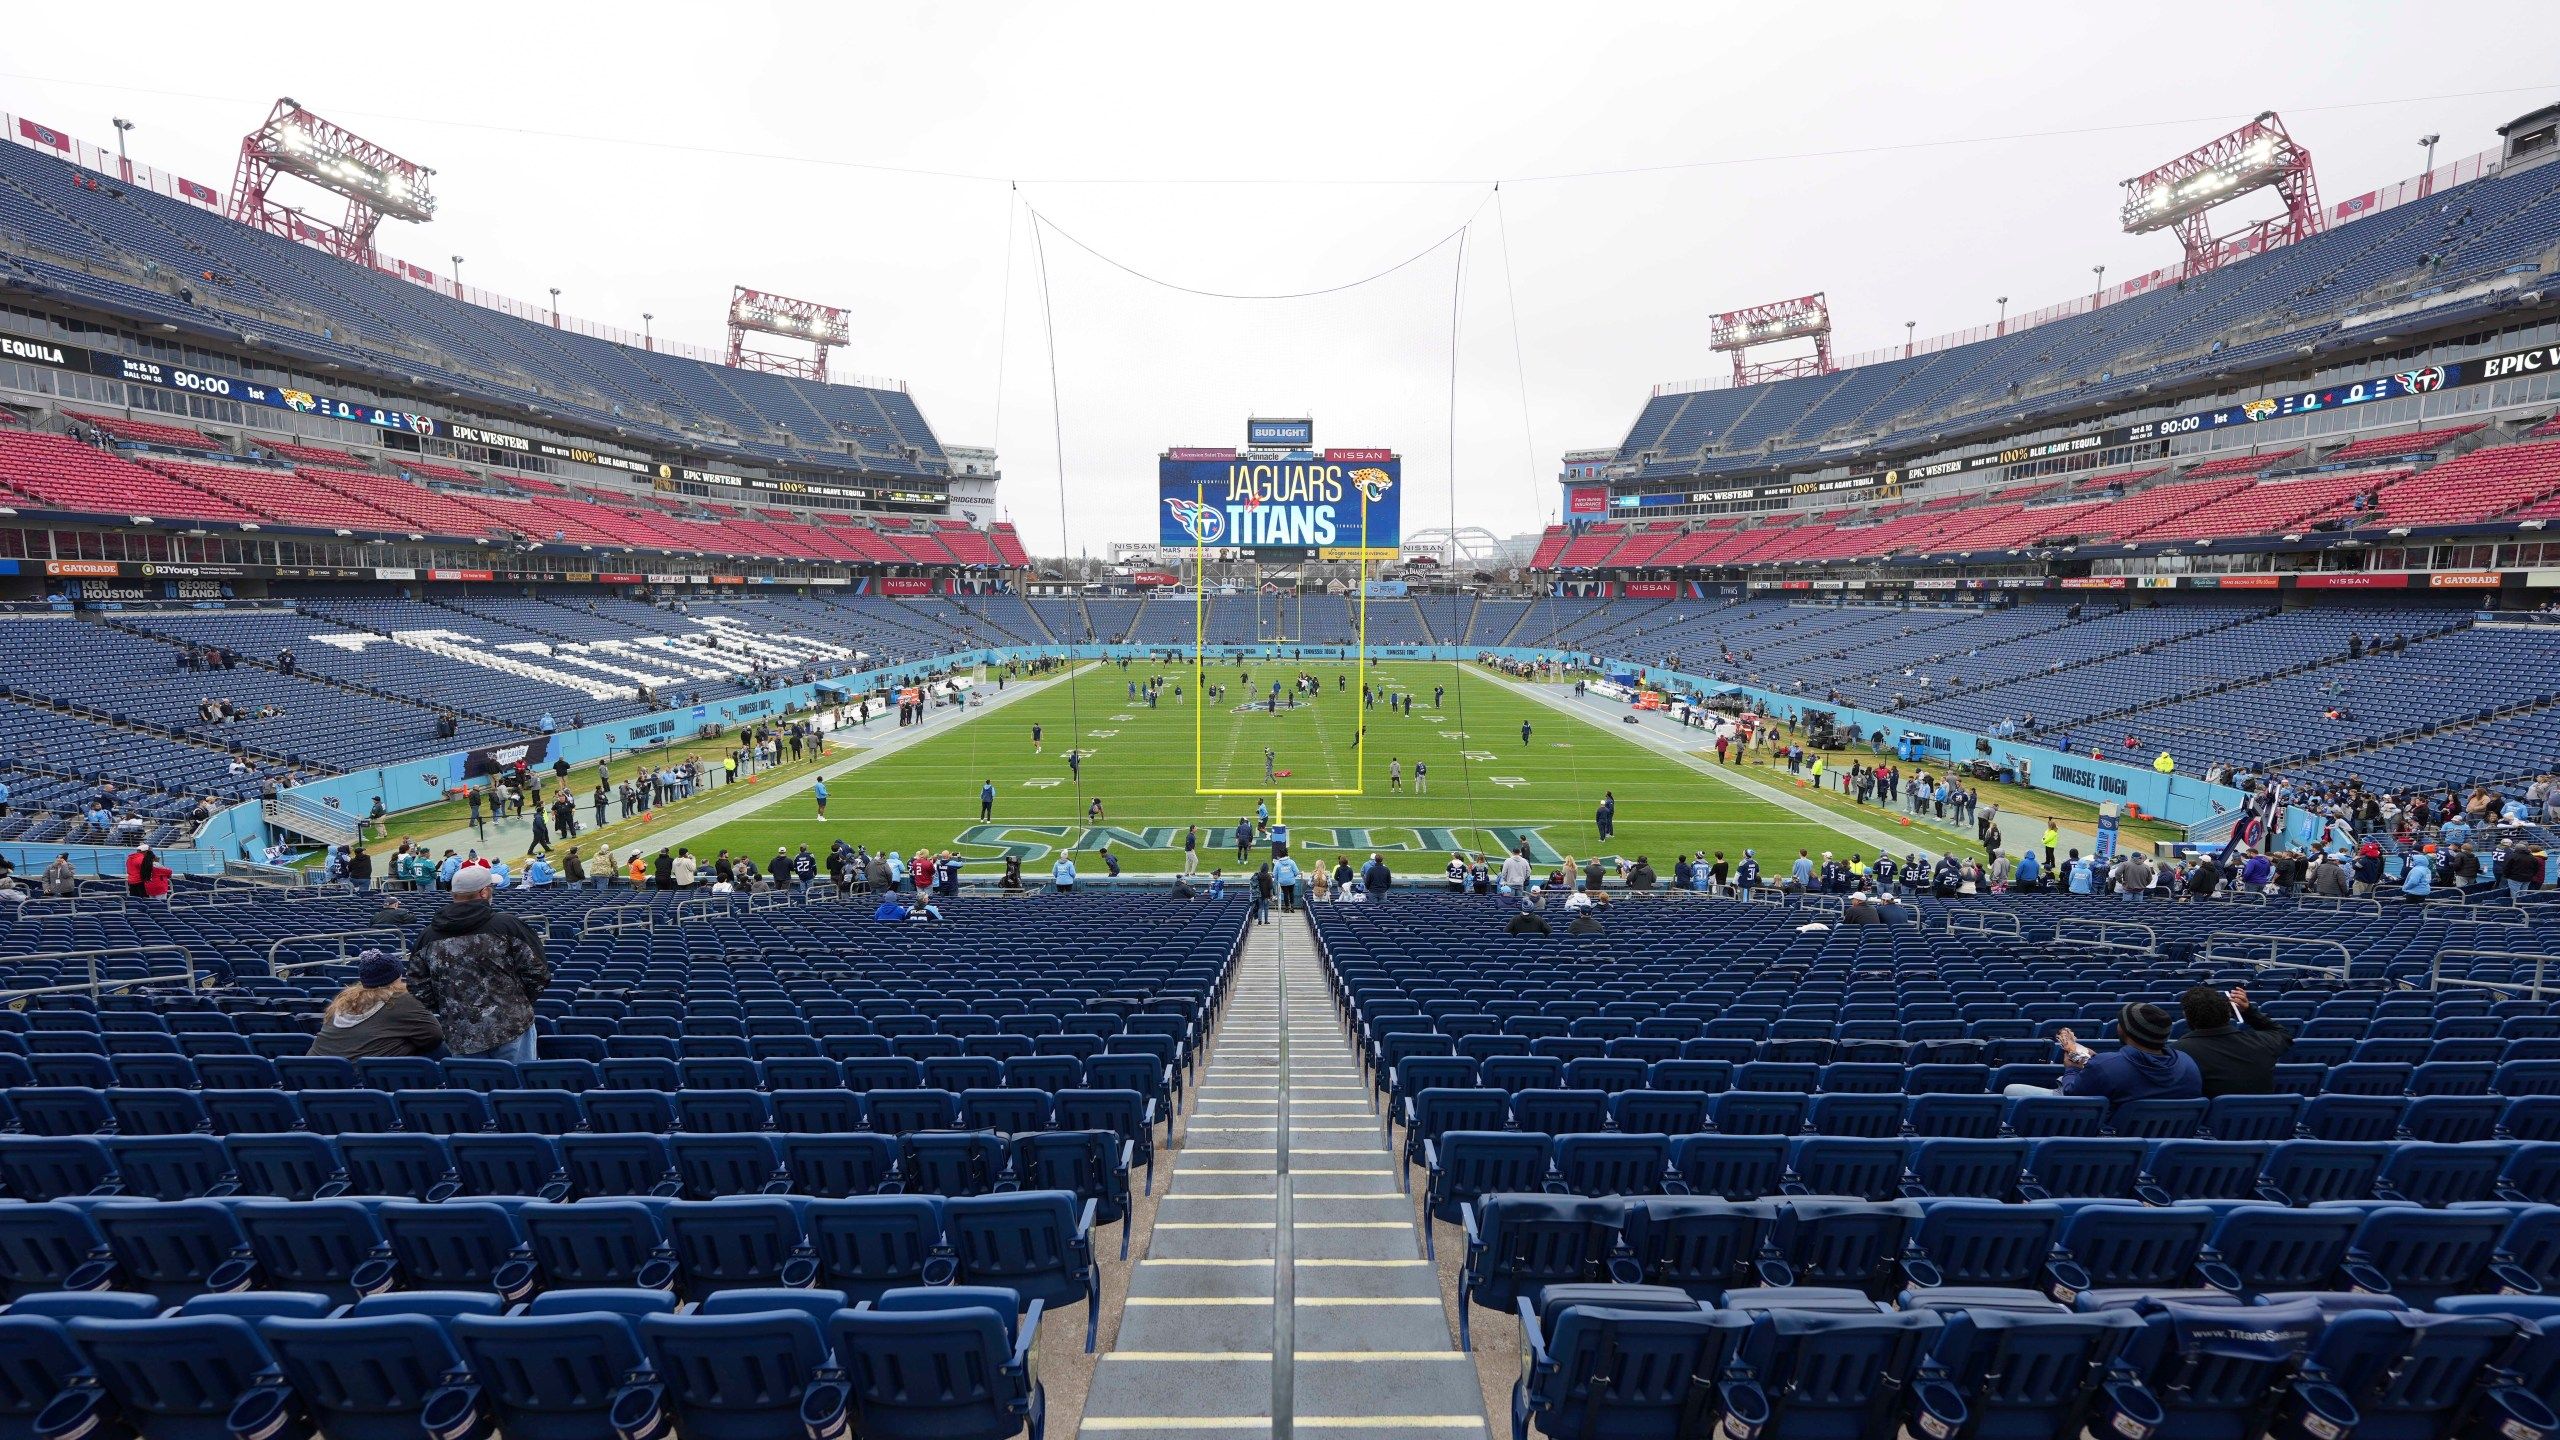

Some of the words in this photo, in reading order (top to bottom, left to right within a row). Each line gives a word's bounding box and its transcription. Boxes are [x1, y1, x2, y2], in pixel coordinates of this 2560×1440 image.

[123, 360, 138, 371] 1st
[139, 363, 147, 372] &
[148, 365, 159, 375] 10
[2484, 351, 2543, 378] EPIC
[123, 371, 141, 380] BALL
[174, 371, 230, 395] 90:00
[247, 387, 265, 400] 1st
[2350, 384, 2364, 399] 0
[2303, 393, 2316, 408] 0
[338, 403, 349, 416] 0
[375, 409, 385, 423] 0
[2160, 416, 2200, 434] 90:00
[2213, 413, 2228, 424] 1st
[453, 425, 479, 441] EPIC
[480, 432, 529, 450] WESTERN
[1255, 428, 1275, 437] BUD
[1276, 428, 1306, 437] LIGHT
[1248, 452, 1279, 461] Pinnacle
[1972, 458, 1985, 466] MADE
[1985, 456, 1998, 464] WITH
[1999, 448, 2028, 463] 100%
[2029, 446, 2047, 457] BLUE
[2047, 442, 2069, 454] AGAVE
[2071, 436, 2102, 451] TEQUILA
[541, 445, 556, 454] MADE
[556, 448, 570, 457] WITH
[570, 448, 597, 464] 100%
[598, 455, 612, 466] BLUE
[612, 457, 629, 469] AGAVE
[629, 461, 649, 473] TEQUILA
[1908, 468, 1926, 480] EPIC
[1926, 462, 1961, 477] WESTERN
[683, 470, 701, 481] EPIC
[702, 472, 742, 486] WESTERN
[1225, 465, 1343, 502] JAGUARS
[779, 482, 806, 493] 100%
[807, 487, 822, 495] BLUE
[823, 488, 841, 496] AGAVE
[842, 489, 866, 498] TEQUILA
[1792, 482, 1818, 494] 100%
[1819, 483, 1834, 491] BLUE
[1834, 480, 1852, 489] AGAVE
[1853, 477, 1874, 487] TEQUILA
[1693, 491, 1713, 502] EPIC
[1714, 489, 1754, 500] WESTERN
[1226, 504, 1336, 544] TITANS
[1327, 549, 1346, 558] Kroger
[62, 564, 117, 573] GATORADE
[155, 566, 199, 577] RJYoung
[82, 580, 109, 590] KEN
[178, 581, 221, 590] GEORGE
[1966, 580, 1983, 588] FedEx
[2144, 578, 2169, 587] WM
[2444, 576, 2498, 584] GATORADE
[83, 589, 144, 599] HOUSTON
[179, 589, 222, 598] BLANDA
[739, 701, 758, 715] TENNESSEE
[758, 699, 771, 711] TOUGH
[629, 723, 657, 740] TENNESSEE
[659, 719, 675, 733] TOUGH
[1932, 736, 1951, 751] TOUGH
[508, 748, 526, 758] CAUSE
[2052, 764, 2096, 789] TENNESSEE
[2098, 775, 2128, 796] TOUGH
[2435, 855, 2446, 867] 22
[2492, 851, 2505, 862] 22
[797, 861, 809, 871] 22
[916, 866, 922, 875] 2
[1880, 865, 1891, 875] 17
[1450, 868, 1462, 878] 22
